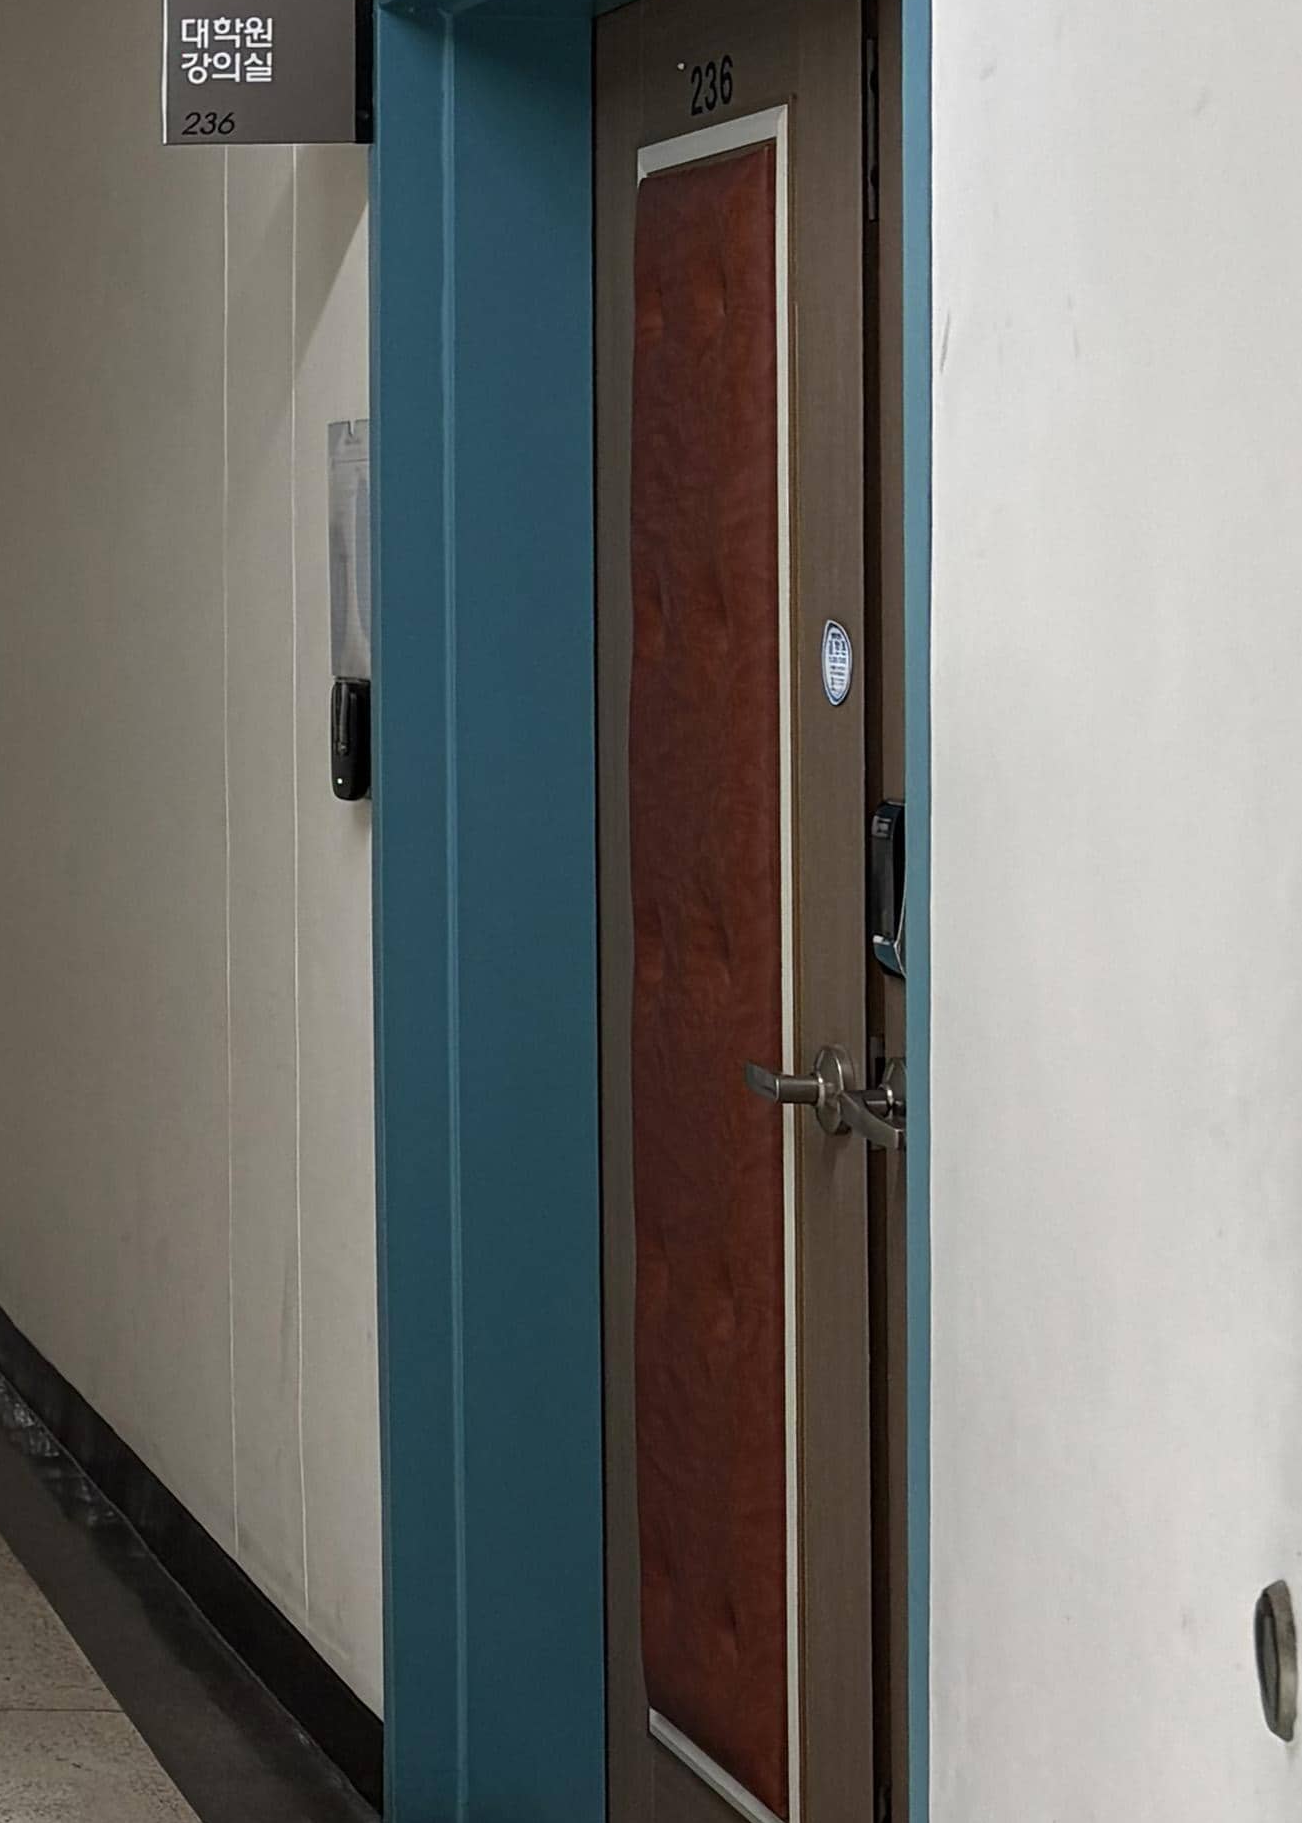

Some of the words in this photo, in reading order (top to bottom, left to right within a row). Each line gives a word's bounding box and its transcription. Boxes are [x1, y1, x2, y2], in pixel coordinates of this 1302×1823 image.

[180, 16, 273, 49] 대학원
[180, 52, 273, 85] 강의실
[690, 54, 734, 116] 236
[181, 111, 236, 136] 236
